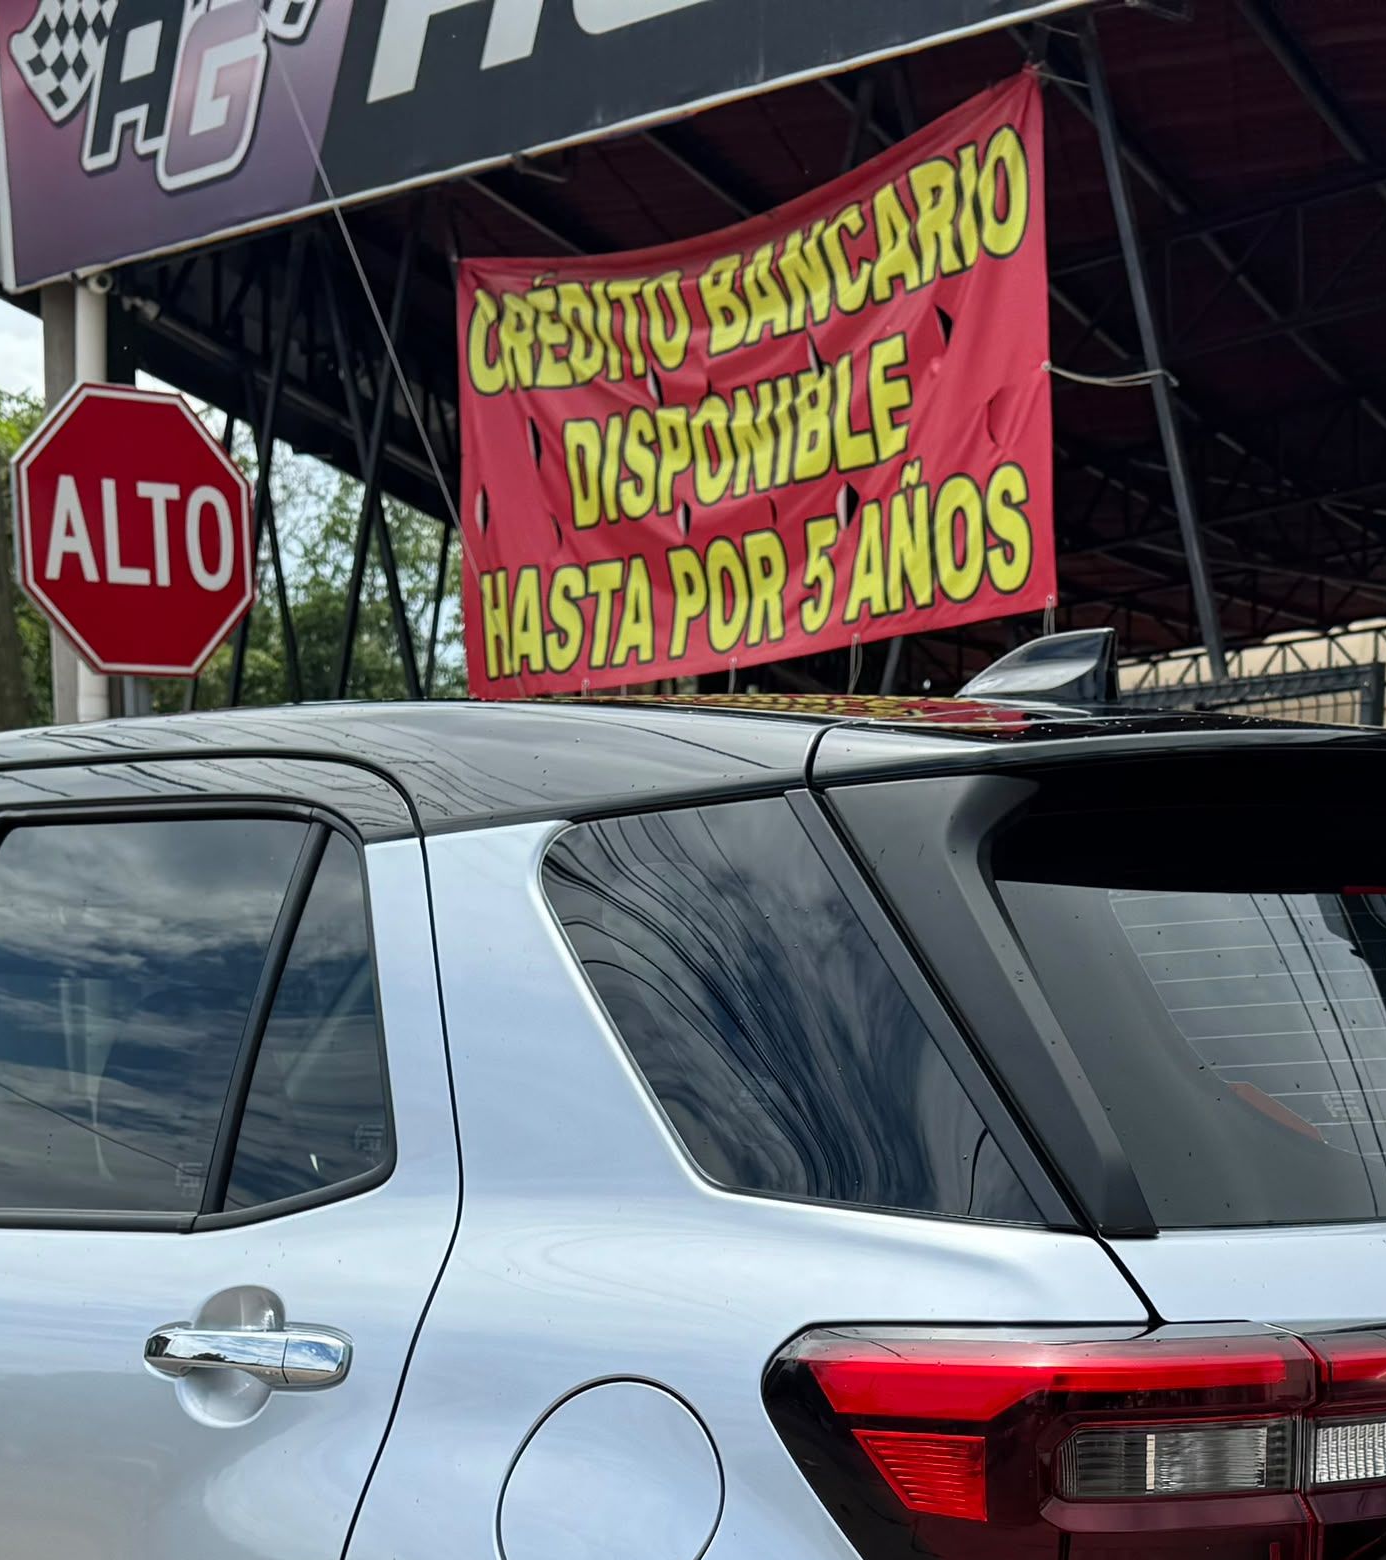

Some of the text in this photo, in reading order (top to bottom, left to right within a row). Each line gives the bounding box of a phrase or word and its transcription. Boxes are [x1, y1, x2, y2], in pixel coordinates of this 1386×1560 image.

[468, 124, 1028, 395] CRÉDITO BANCARIO
[44, 474, 235, 592] ALTO
[564, 332, 912, 529] DISPONIBLE
[480, 460, 1033, 681] HASTA POR 5 AÑOS
